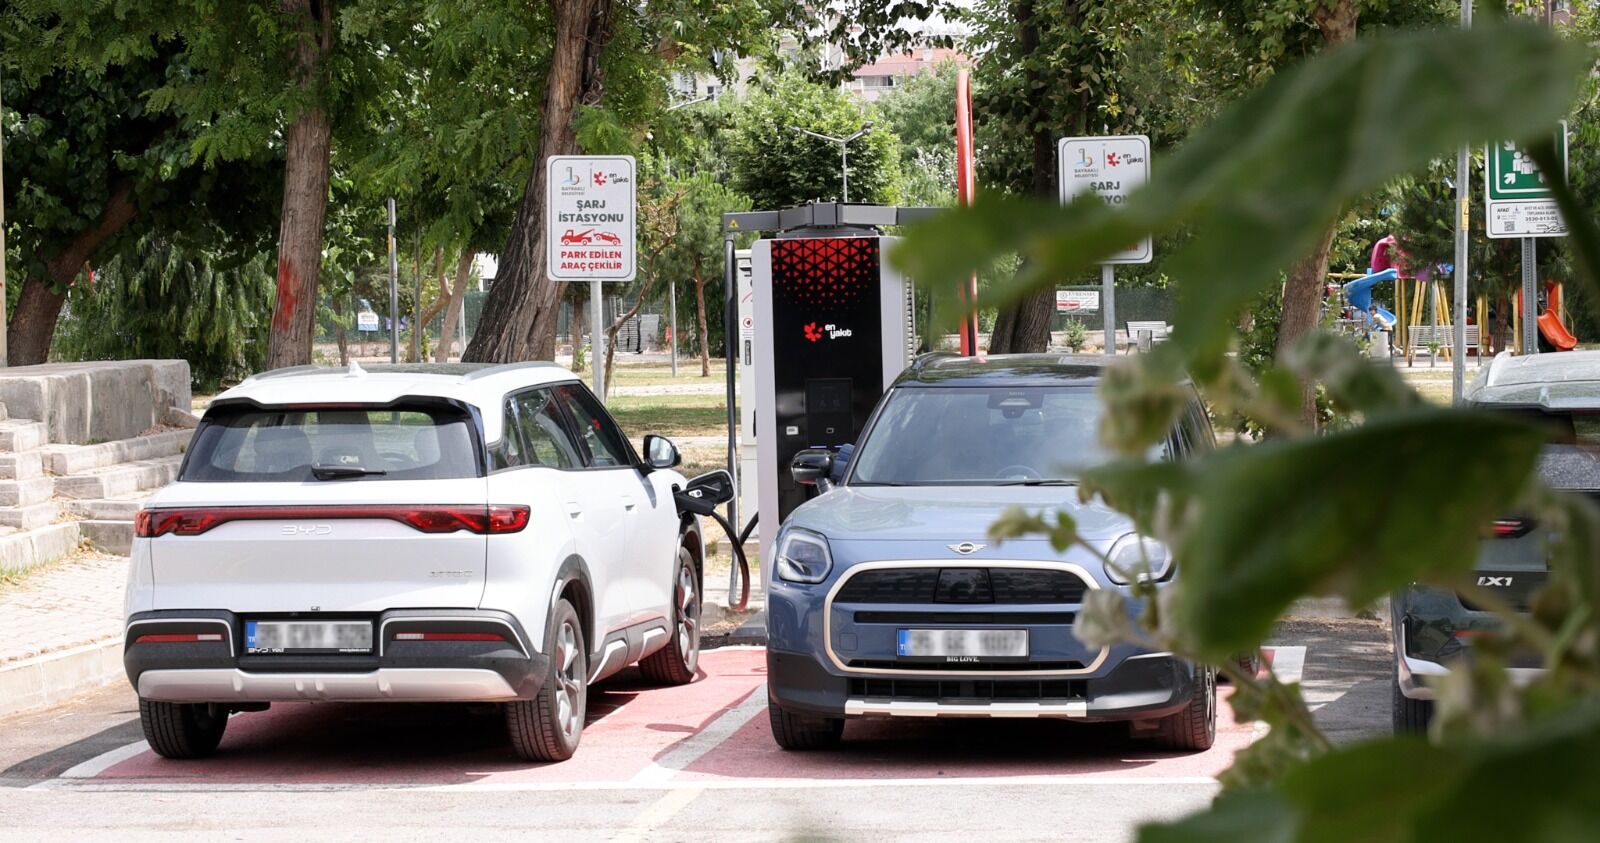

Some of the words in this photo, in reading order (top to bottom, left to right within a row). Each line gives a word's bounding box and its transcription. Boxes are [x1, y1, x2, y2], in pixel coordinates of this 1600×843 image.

[576, 200, 606, 212] ŞARJ
[558, 211, 624, 223] İSTASYONU
[561, 251, 587, 259] PARK
[589, 249, 622, 259] EDİLEN
[561, 262, 586, 271] ARAÇ
[588, 260, 622, 271] ÇEKİLİR
[282, 524, 332, 536] BYD
